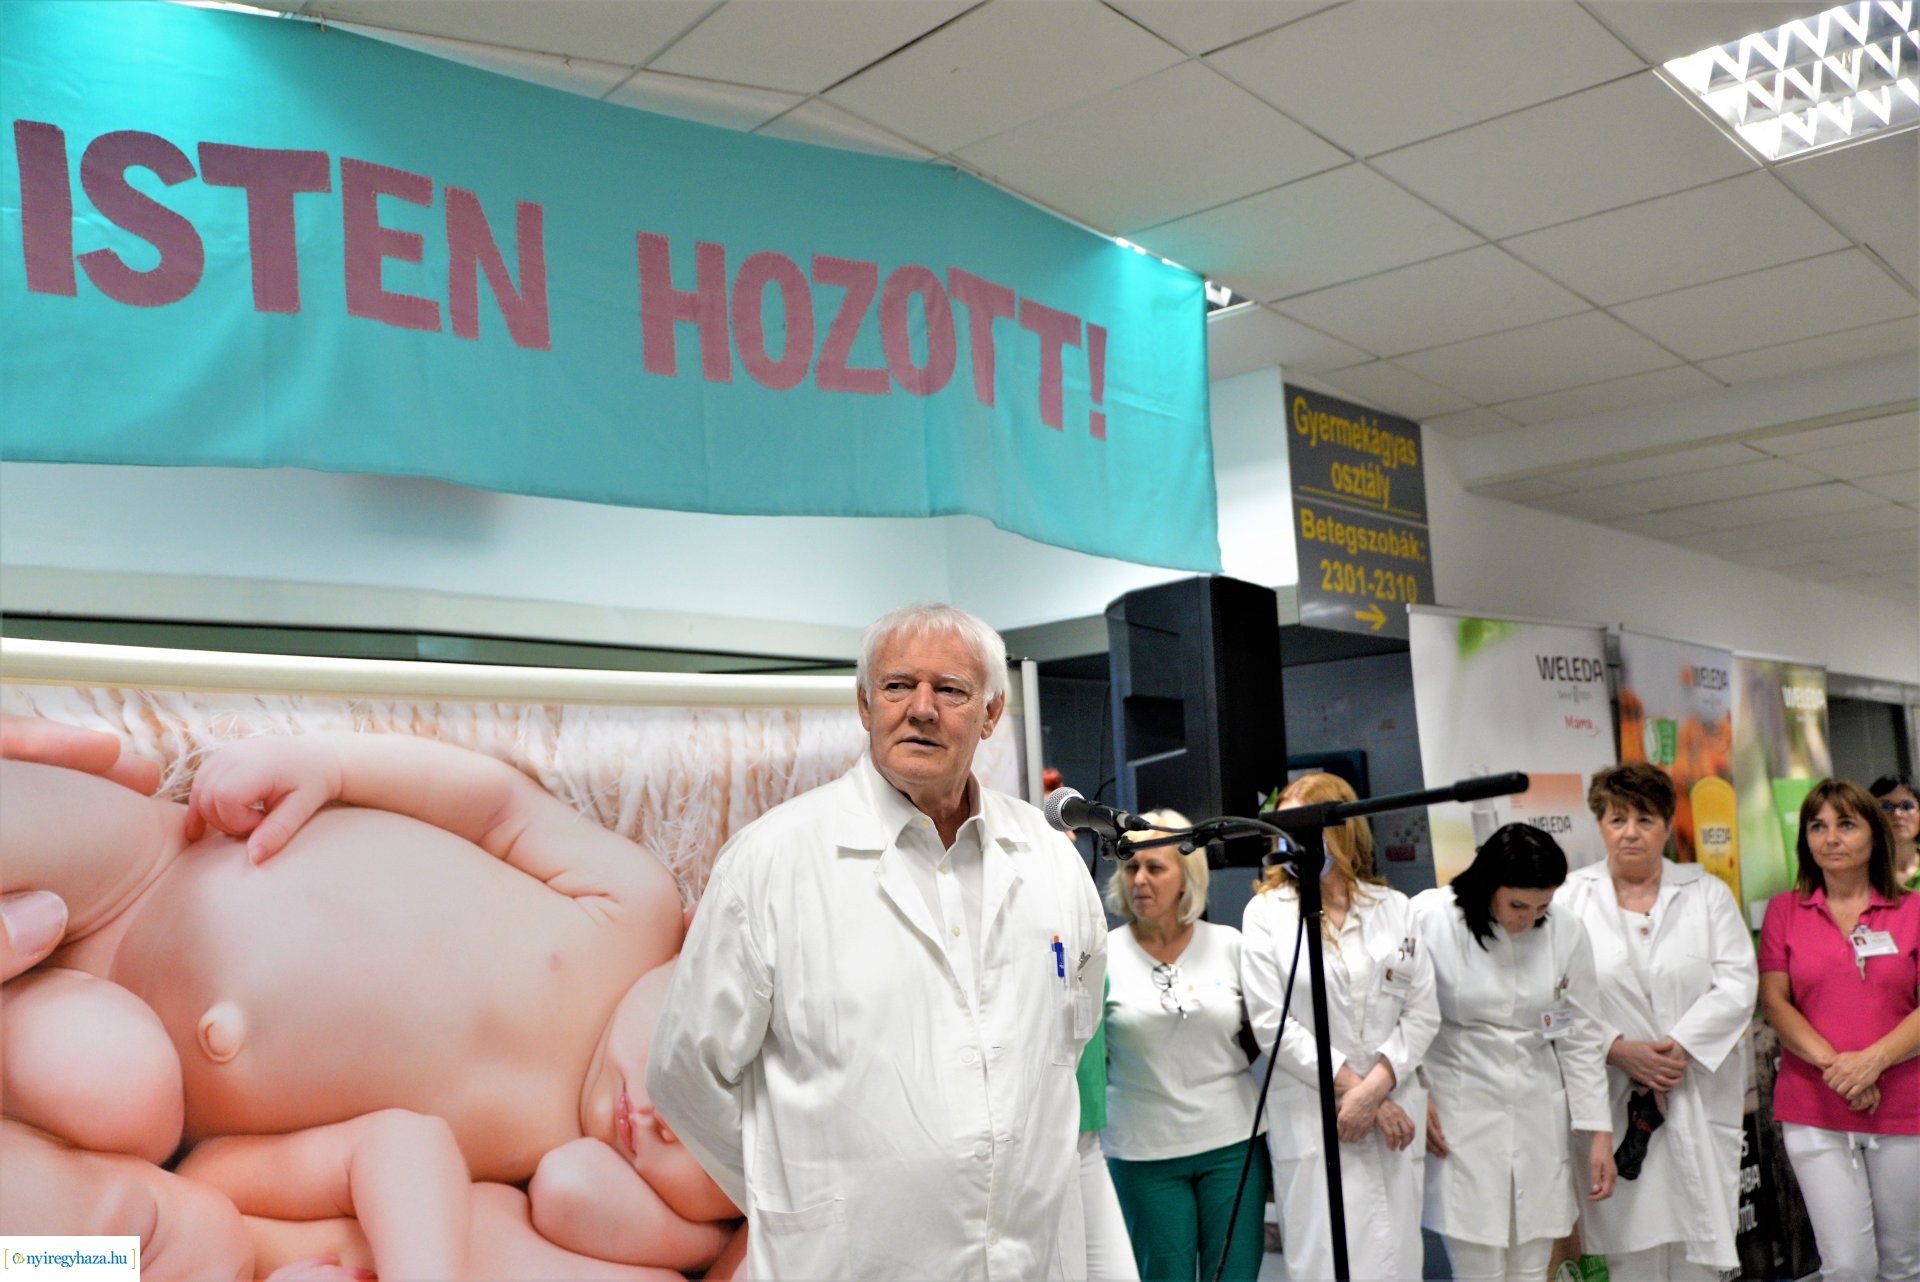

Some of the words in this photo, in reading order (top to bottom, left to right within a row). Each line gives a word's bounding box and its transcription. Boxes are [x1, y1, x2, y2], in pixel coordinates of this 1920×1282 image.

[13, 118, 551, 352] ISTEN
[637, 230, 1108, 441] HOZOTT!
[1293, 395, 1418, 468] Gyermekágyas
[1330, 461, 1391, 510] osztály
[1300, 507, 1427, 562] Betegszobák:
[1320, 558, 1418, 604] 2301-2310
[1535, 653, 1604, 683] WELEDA
